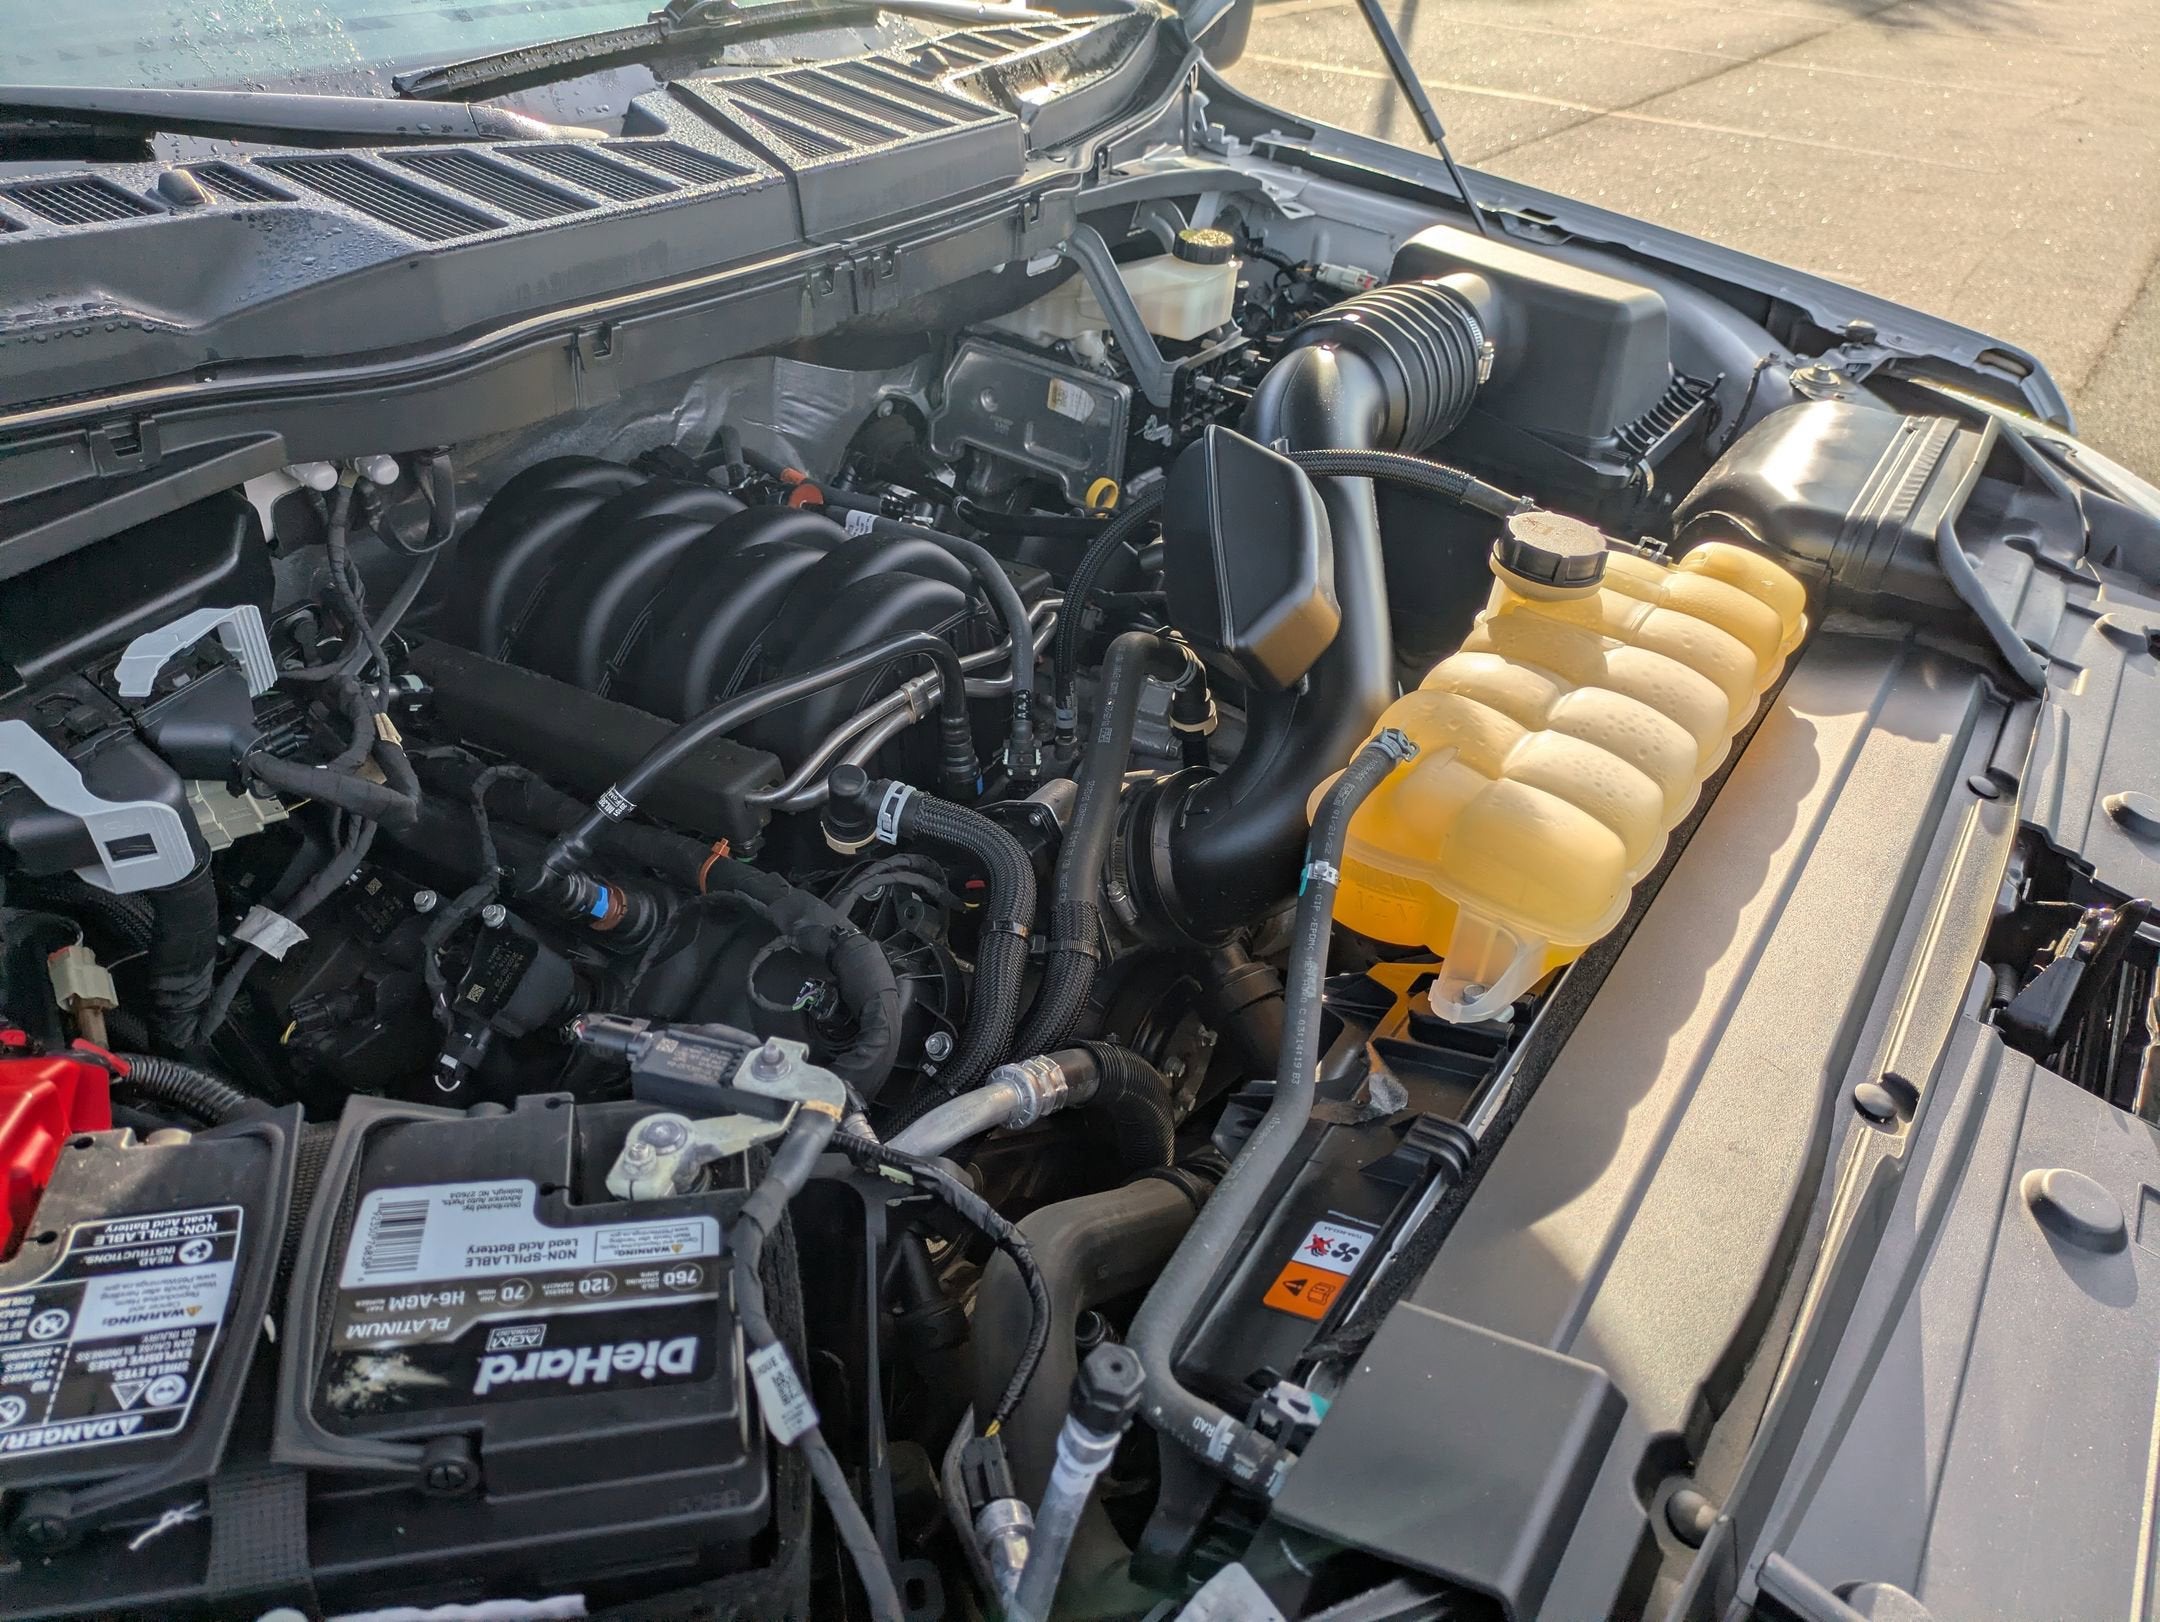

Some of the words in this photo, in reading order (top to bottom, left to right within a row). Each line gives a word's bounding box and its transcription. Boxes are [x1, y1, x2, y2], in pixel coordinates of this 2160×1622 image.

[104, 1221, 150, 1233] Battery
[153, 1218, 181, 1229] Acid
[184, 1213, 213, 1225] Lead
[93, 1221, 218, 1246] NON-SPILLABLE
[467, 1243, 516, 1255] Battery
[518, 1240, 545, 1253] Acid
[548, 1238, 578, 1249] Lead
[139, 1254, 174, 1267] READ
[464, 1249, 577, 1268] NON-SPILLABLE
[579, 1277, 610, 1294] 120
[663, 1269, 697, 1286] 760
[388, 1290, 465, 1312] H6-AGM
[501, 1285, 525, 1302] 70
[102, 1308, 185, 1327] WARNING:
[345, 1317, 452, 1340] PLATINUM
[492, 1334, 540, 1348] AGM
[473, 1336, 697, 1395] DieHard
